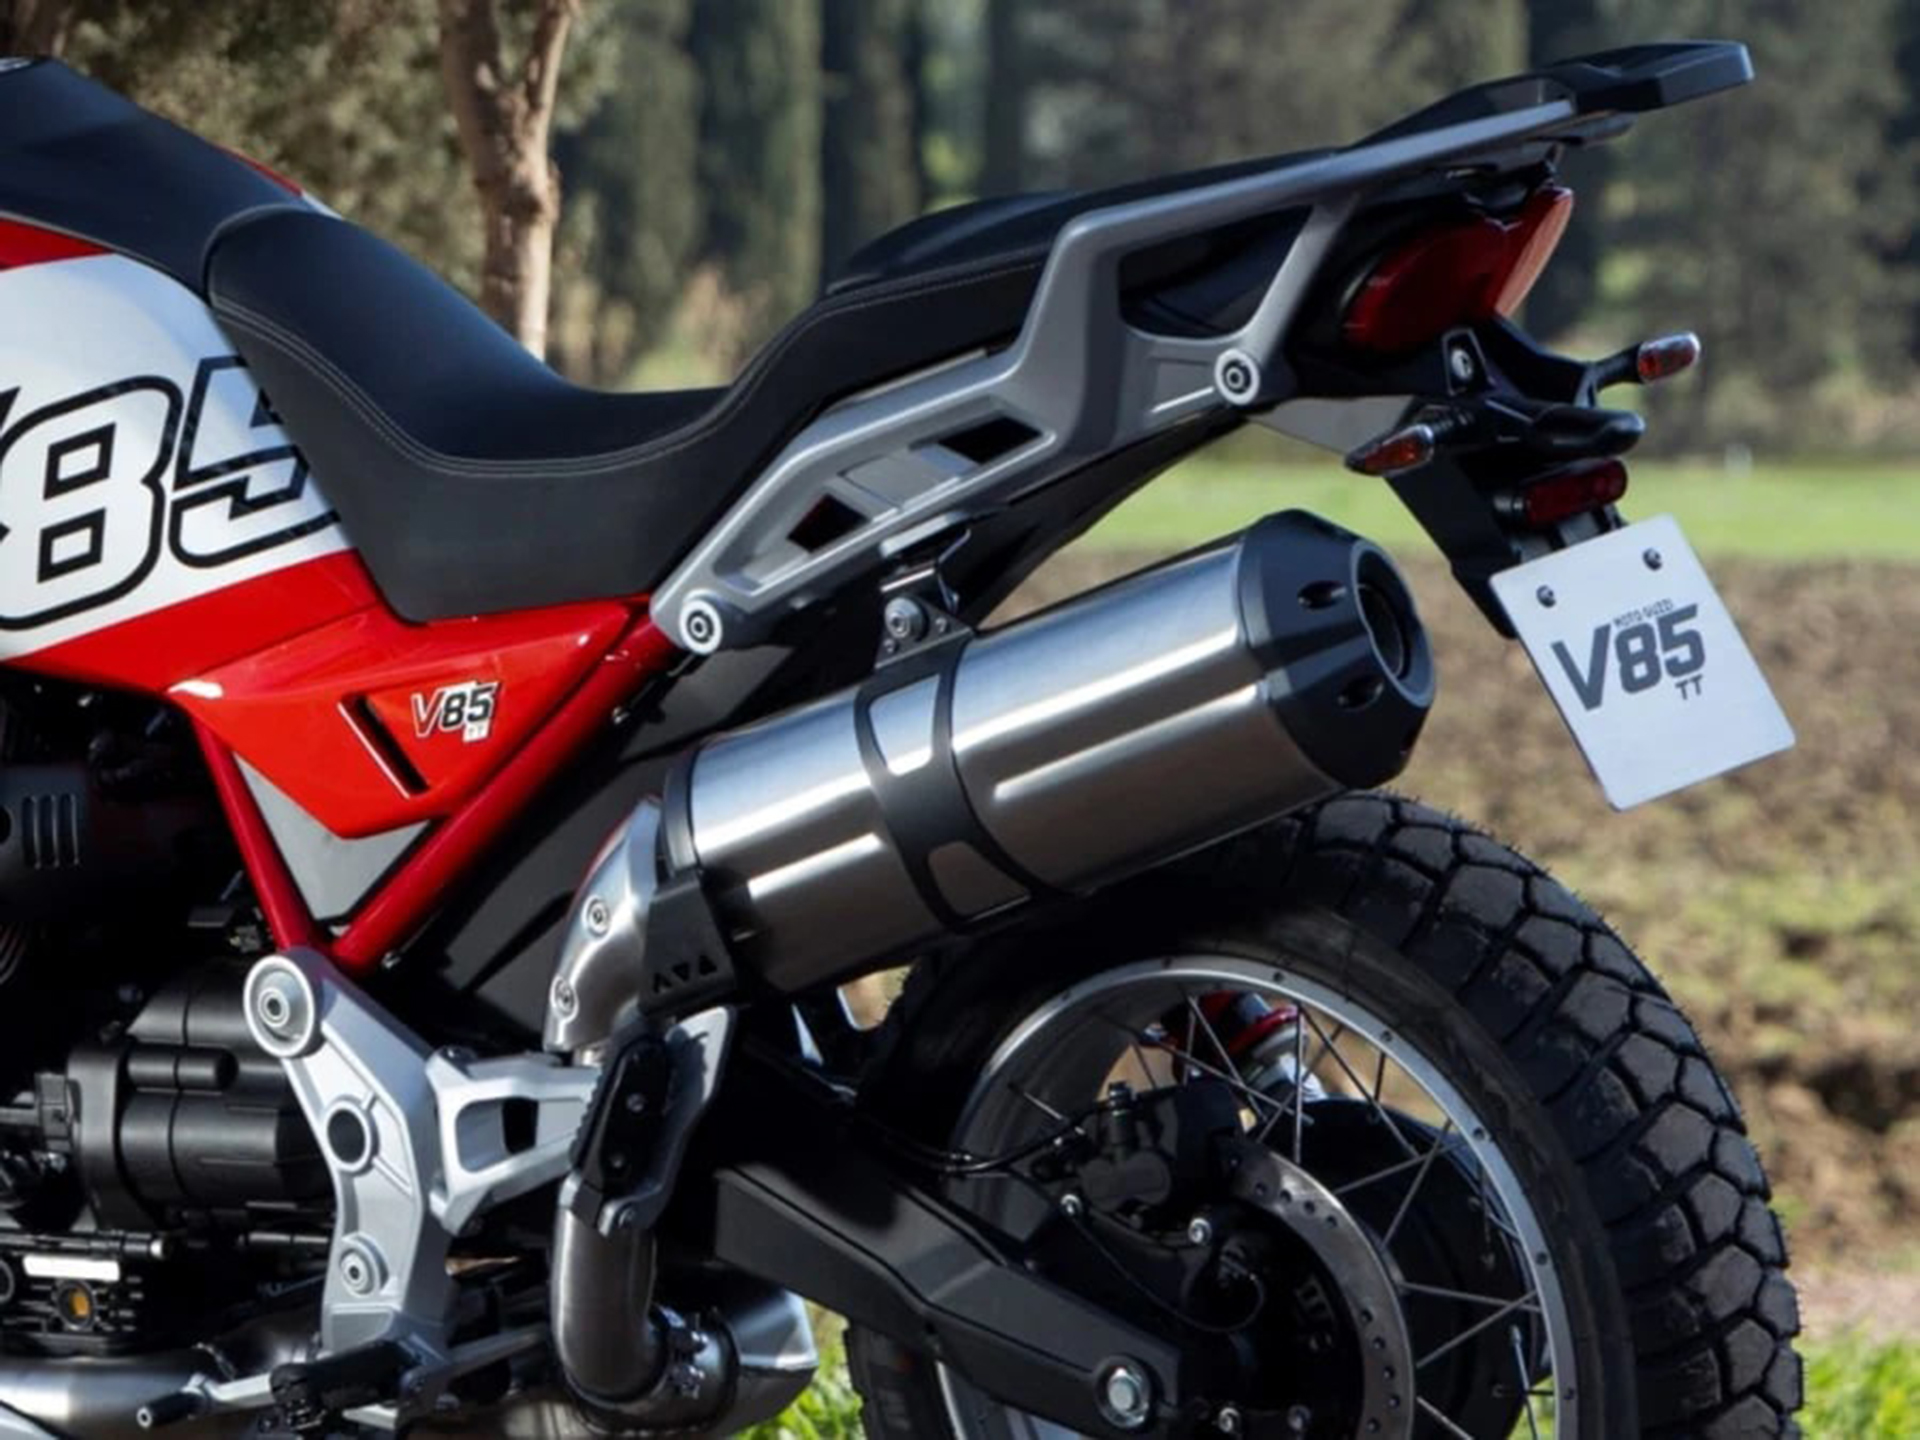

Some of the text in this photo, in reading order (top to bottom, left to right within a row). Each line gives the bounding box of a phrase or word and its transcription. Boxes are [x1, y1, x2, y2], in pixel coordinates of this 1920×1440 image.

[0, 355, 342, 631] 85
[1551, 603, 1705, 711] V85
[1675, 674, 1704, 700] TT
[411, 681, 500, 738] V85
